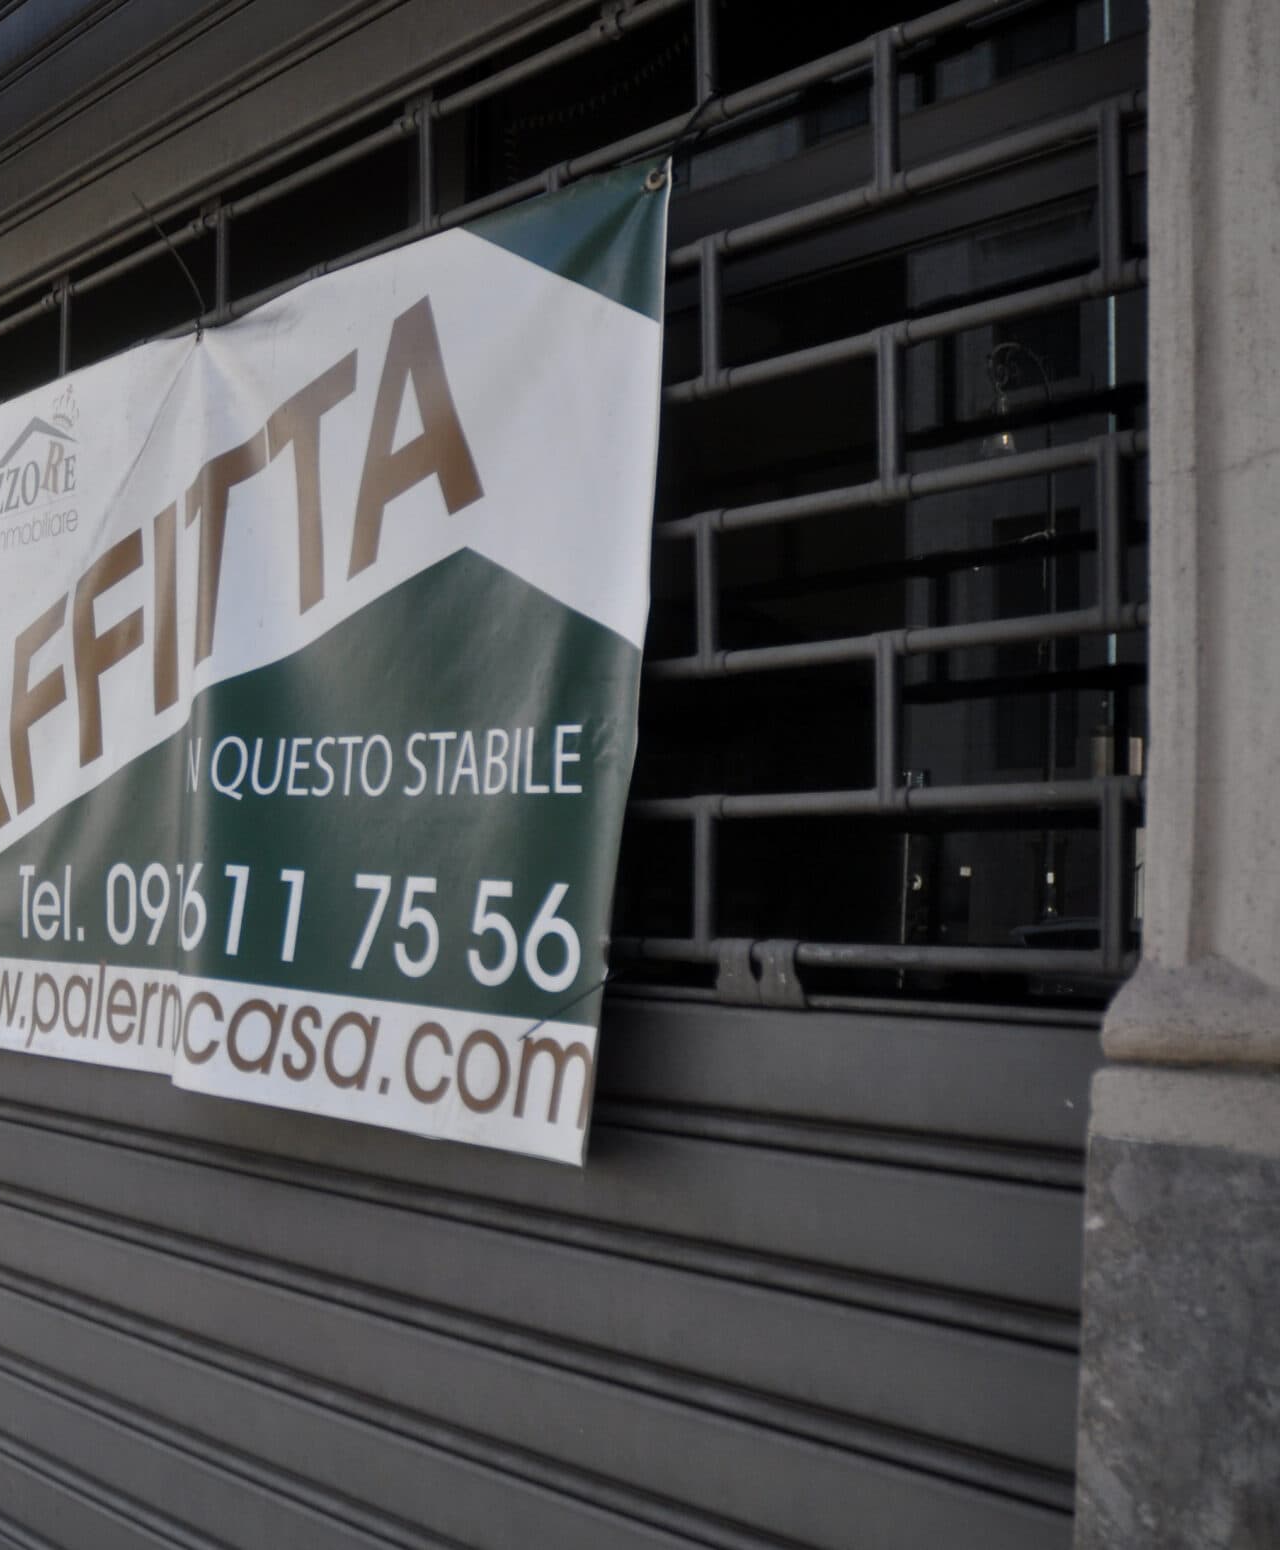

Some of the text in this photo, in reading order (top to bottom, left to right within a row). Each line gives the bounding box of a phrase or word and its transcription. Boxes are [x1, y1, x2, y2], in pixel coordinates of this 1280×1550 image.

[210, 734, 393, 801] QUESTO
[403, 724, 583, 796] STABILE
[19, 864, 85, 943] Tel.
